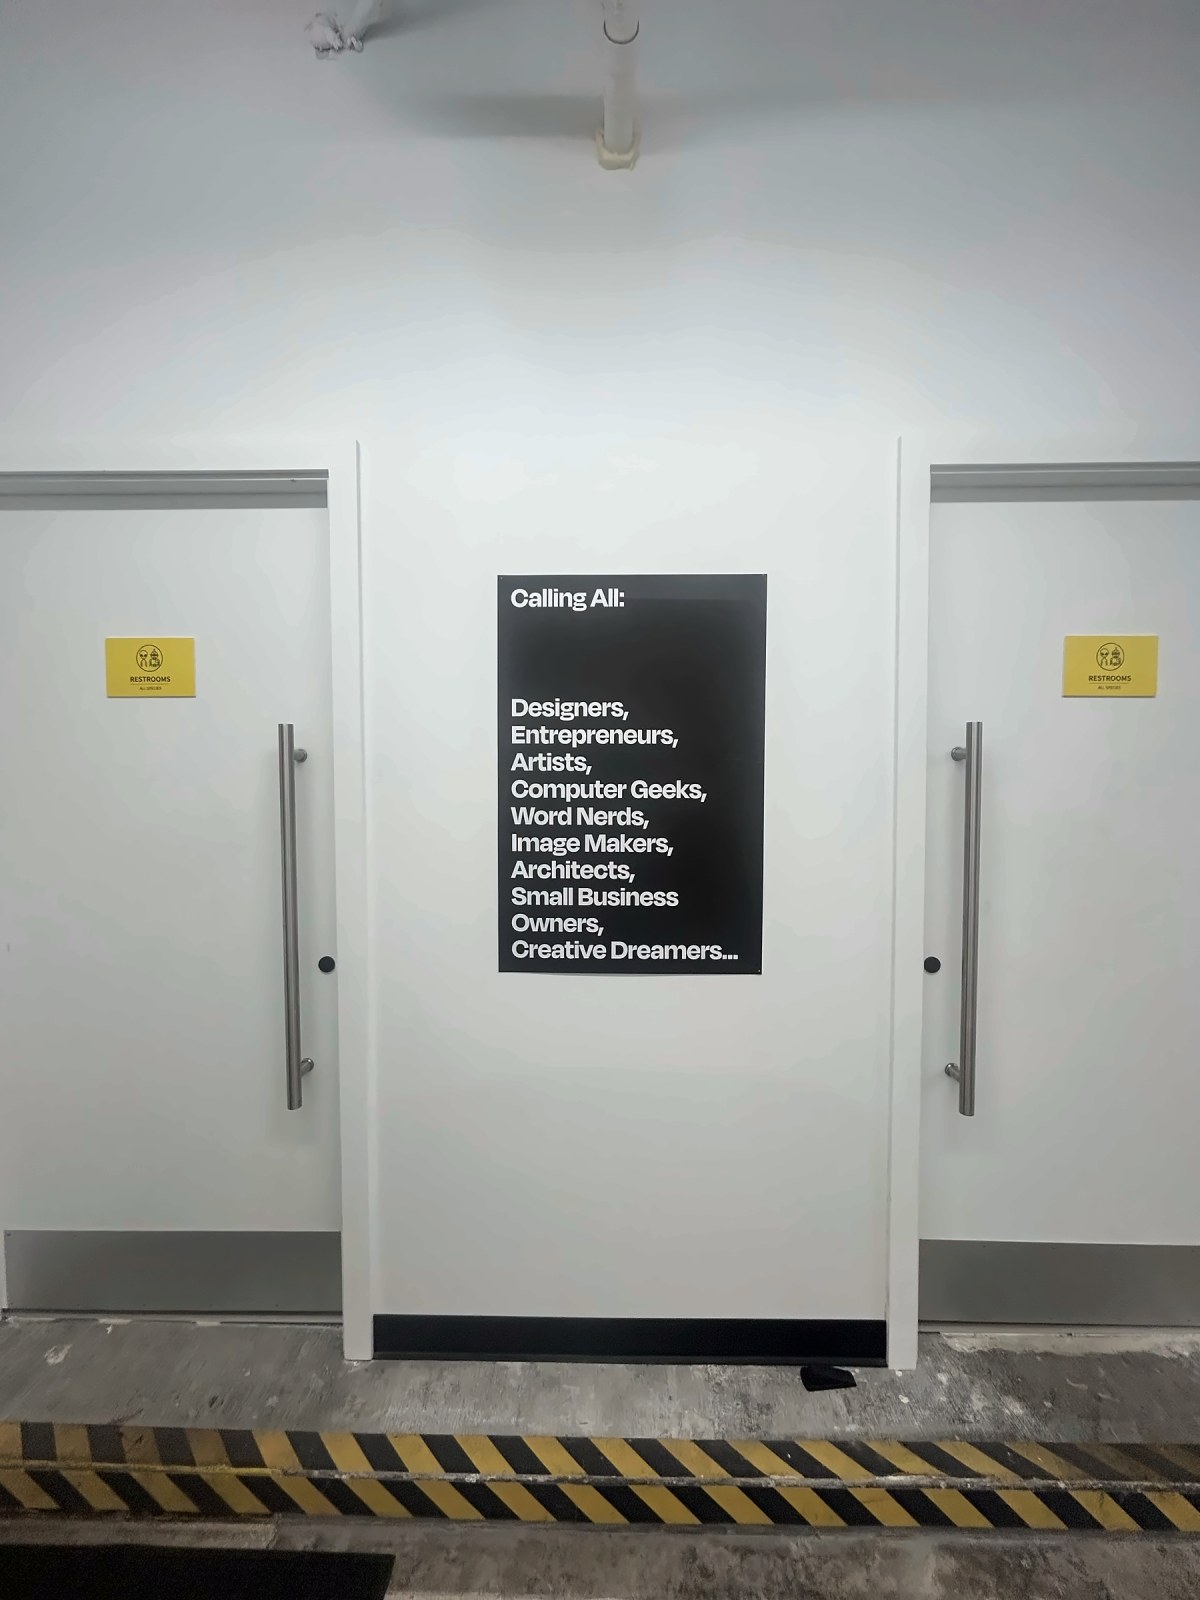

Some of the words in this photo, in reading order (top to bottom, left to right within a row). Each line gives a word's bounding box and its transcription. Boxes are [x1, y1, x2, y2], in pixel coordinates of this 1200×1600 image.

[511, 588, 587, 611] Calling
[590, 588, 624, 607] All:
[512, 698, 629, 721] Designers,
[512, 726, 678, 748] Entrepreneurs,
[511, 753, 592, 775] Artists,
[511, 780, 627, 802] Computer
[631, 780, 707, 802] Geeks,
[511, 807, 572, 825] Word
[577, 807, 649, 829] Nerds,
[512, 834, 580, 856] Image
[585, 834, 673, 856] Makers,
[511, 861, 635, 883] Architects,
[512, 887, 573, 905] Small
[578, 888, 679, 906] Business
[512, 914, 604, 936] Owners,
[512, 940, 606, 959] Creative
[611, 941, 738, 960] Dreamers...
